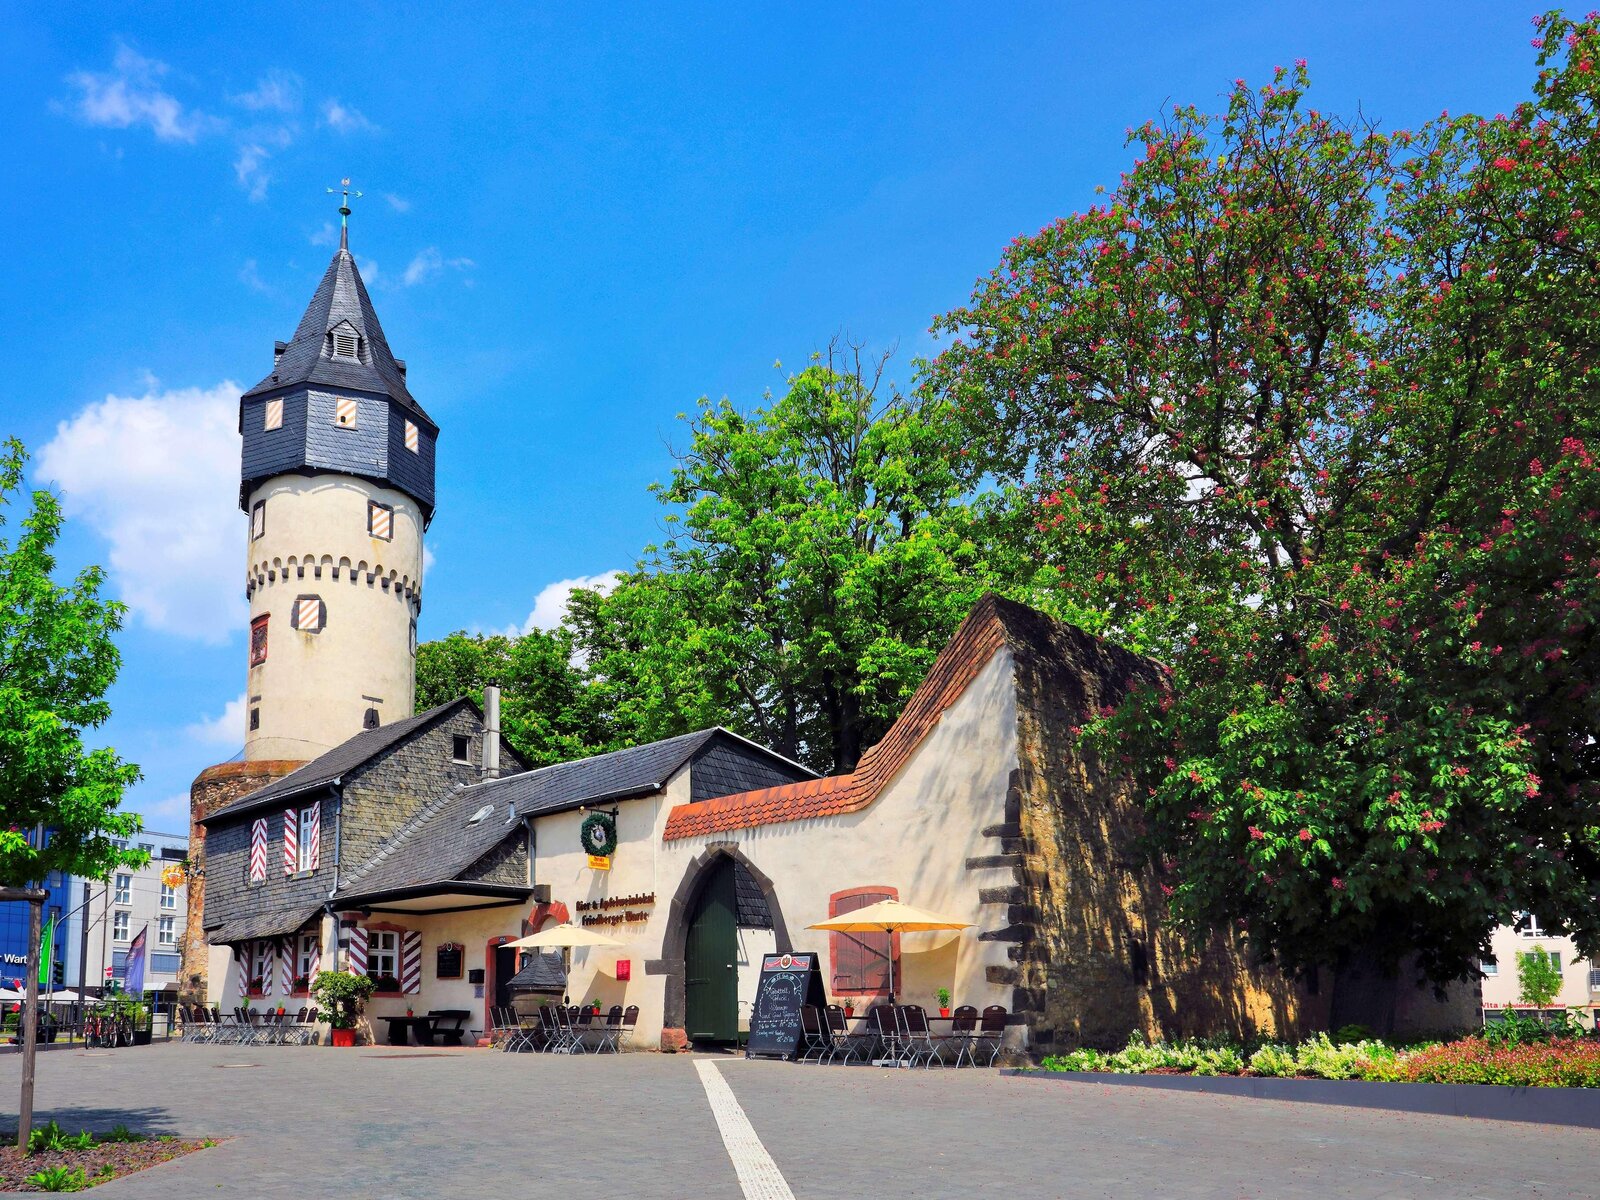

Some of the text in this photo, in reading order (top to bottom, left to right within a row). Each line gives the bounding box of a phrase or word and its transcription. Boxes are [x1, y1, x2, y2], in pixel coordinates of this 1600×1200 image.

[576, 901, 591, 911] Bier
[600, 892, 655, 911] Apfelweinlokal
[582, 911, 649, 926] Friedberger Warte
[4, 953, 28, 964] Wart
